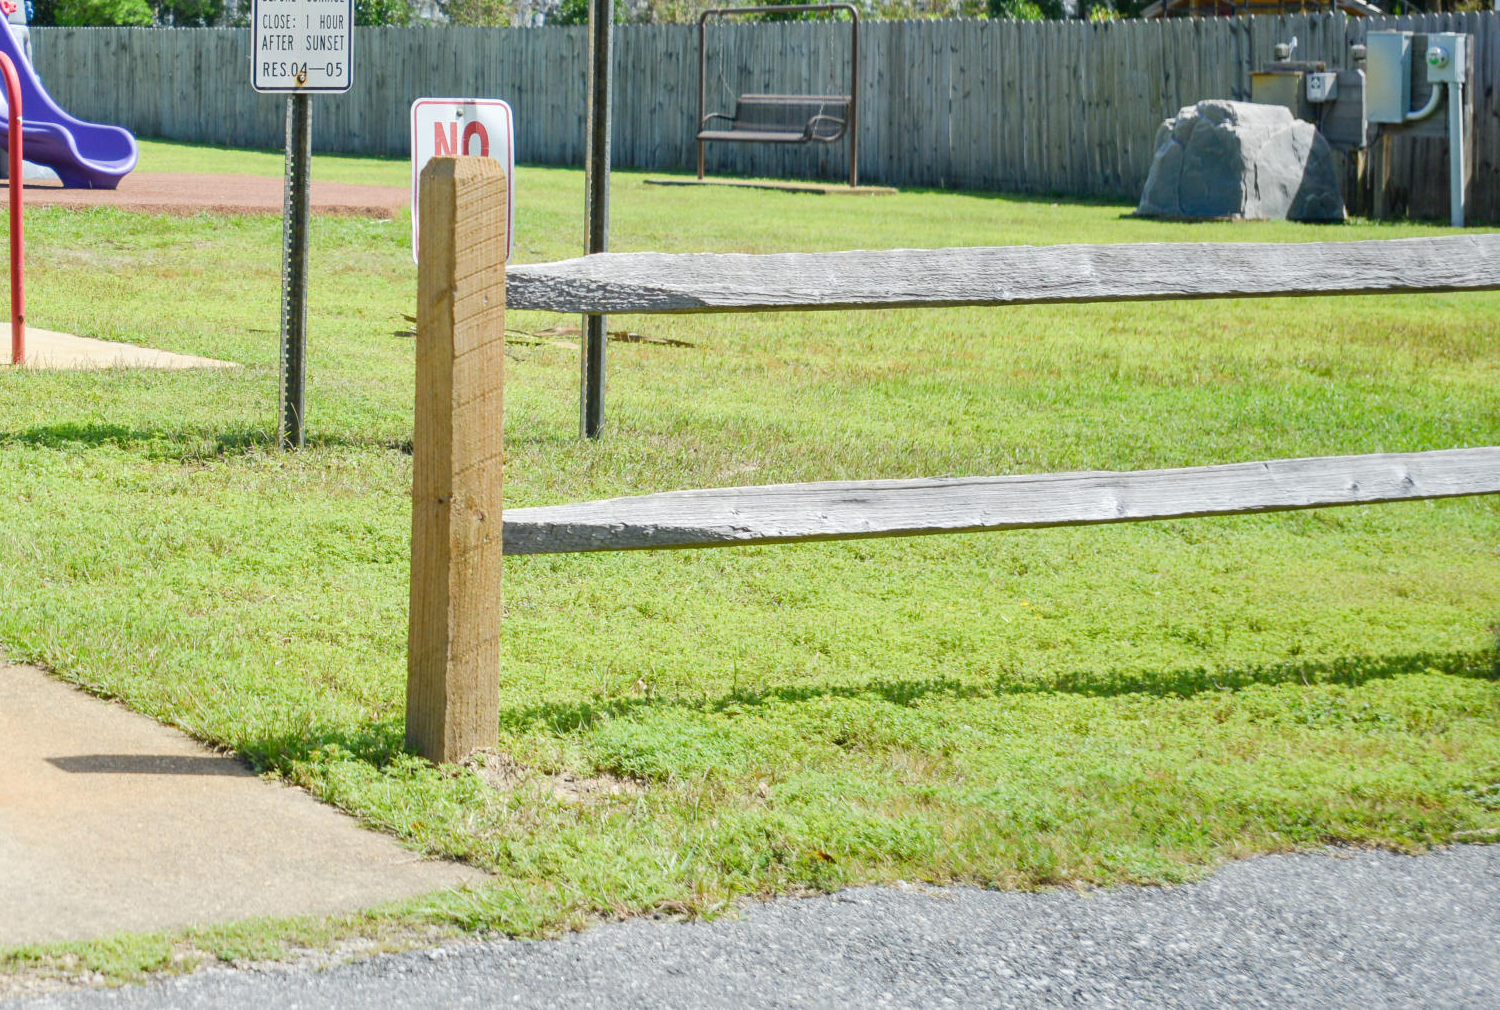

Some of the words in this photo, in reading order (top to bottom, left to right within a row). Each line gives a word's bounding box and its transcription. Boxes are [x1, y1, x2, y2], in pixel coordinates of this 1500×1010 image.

[262, 14, 296, 30] CLOSE:
[306, 14, 310, 30] 1
[319, 15, 344, 30] HOUR
[261, 35, 294, 51] AFTER
[305, 35, 345, 51] SUNSET
[433, 121, 491, 158] NO
